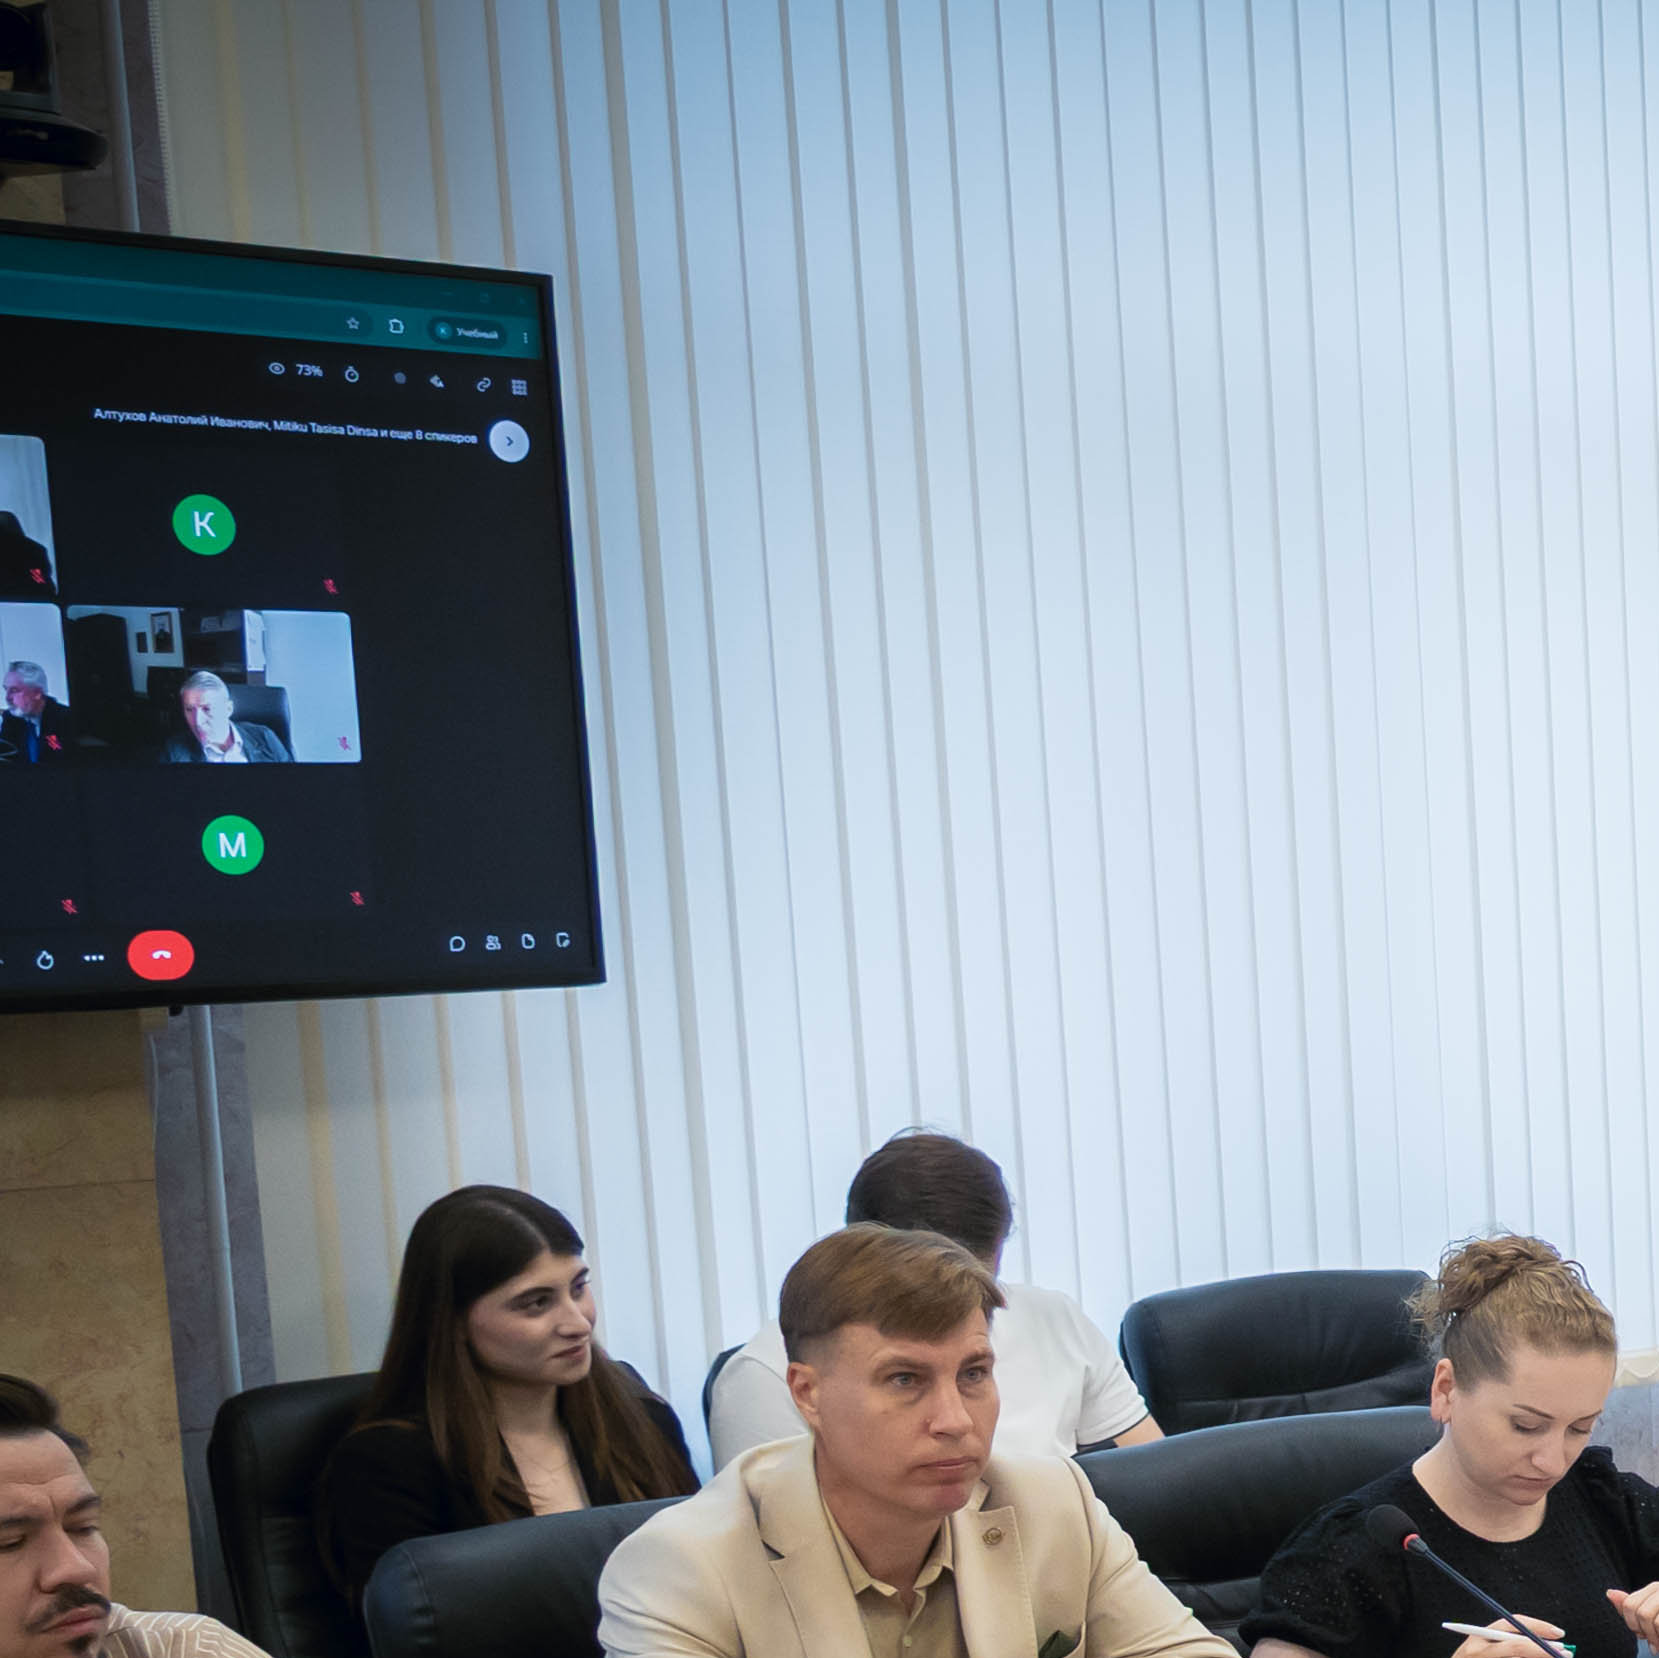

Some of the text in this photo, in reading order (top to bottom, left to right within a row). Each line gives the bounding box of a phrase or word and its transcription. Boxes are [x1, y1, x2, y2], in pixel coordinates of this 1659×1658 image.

[295, 362, 324, 378] 73%
[93, 408, 147, 423] Алтухов
[149, 411, 209, 426] Анатолий
[309, 421, 345, 435] Tasisa
[346, 424, 378, 438] Dinsa
[424, 431, 479, 445] спикеров
